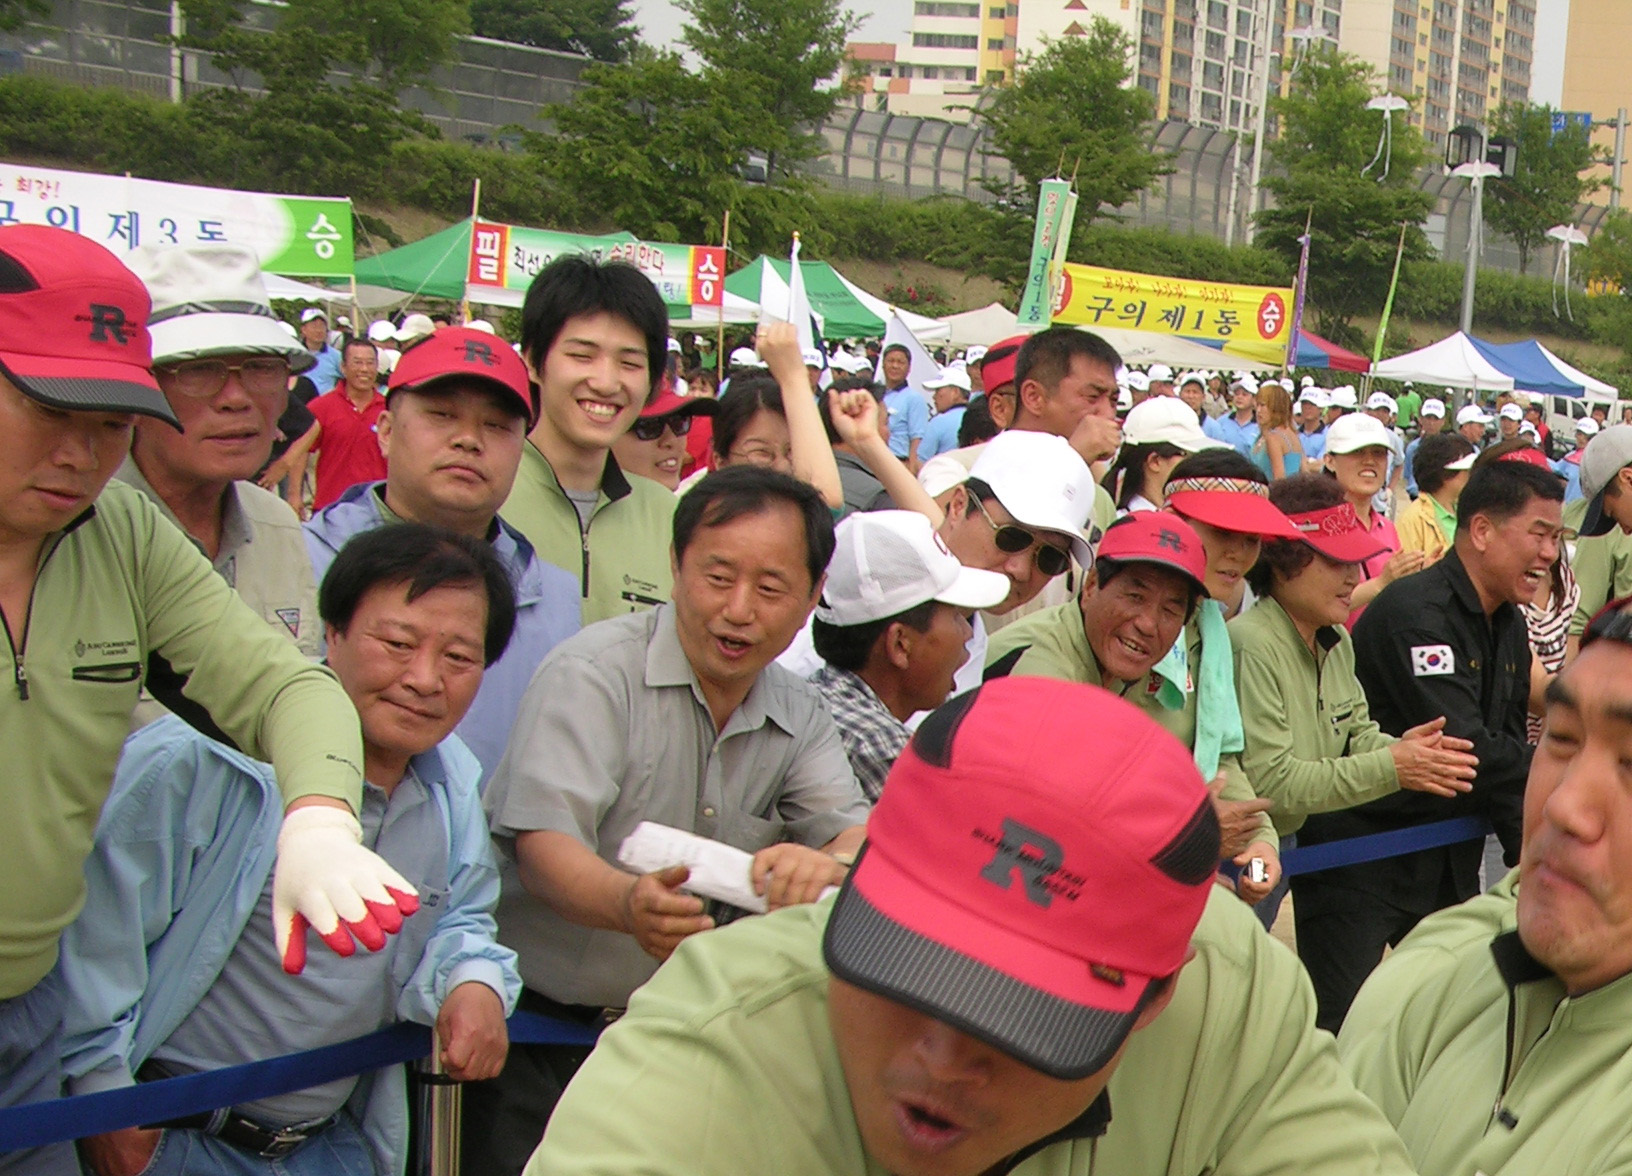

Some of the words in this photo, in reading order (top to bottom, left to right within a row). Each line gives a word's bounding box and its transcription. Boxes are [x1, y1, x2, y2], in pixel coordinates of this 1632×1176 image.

[16, 175, 61, 199] 최강!
[306, 213, 342, 259] 승
[476, 231, 500, 281] 필
[697, 253, 719, 301] 승
[90, 304, 128, 345] R
[1262, 299, 1281, 334] 승
[464, 340, 494, 367] R
[1159, 529, 1181, 553] R
[980, 817, 1065, 909] R
